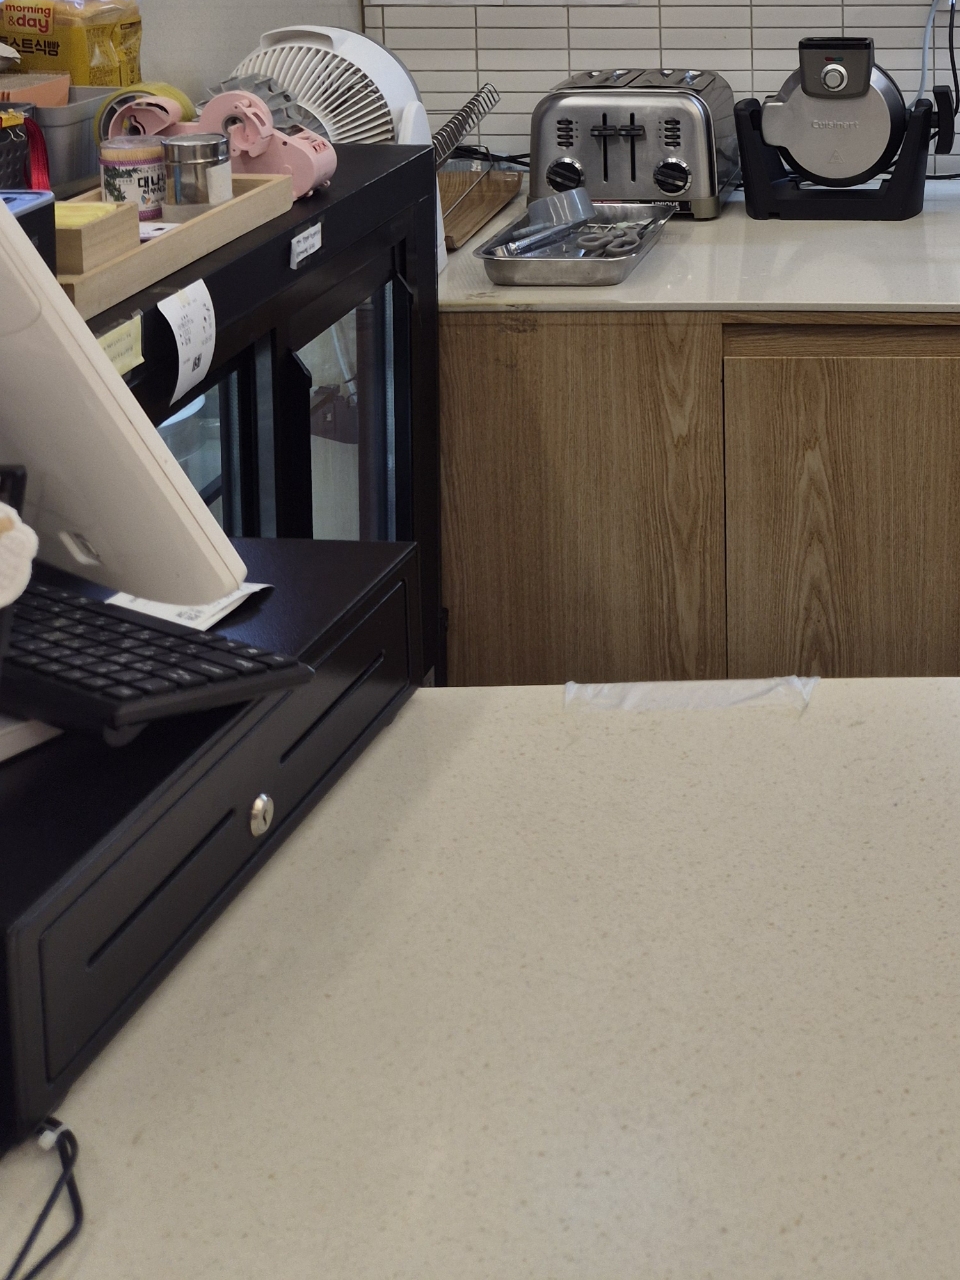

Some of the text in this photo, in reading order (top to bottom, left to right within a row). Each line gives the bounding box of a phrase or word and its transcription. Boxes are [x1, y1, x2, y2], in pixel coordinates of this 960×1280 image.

[6, 4, 51, 18] morning
[8, 14, 49, 34] &day
[812, 120, 859, 129] Cuisinart
